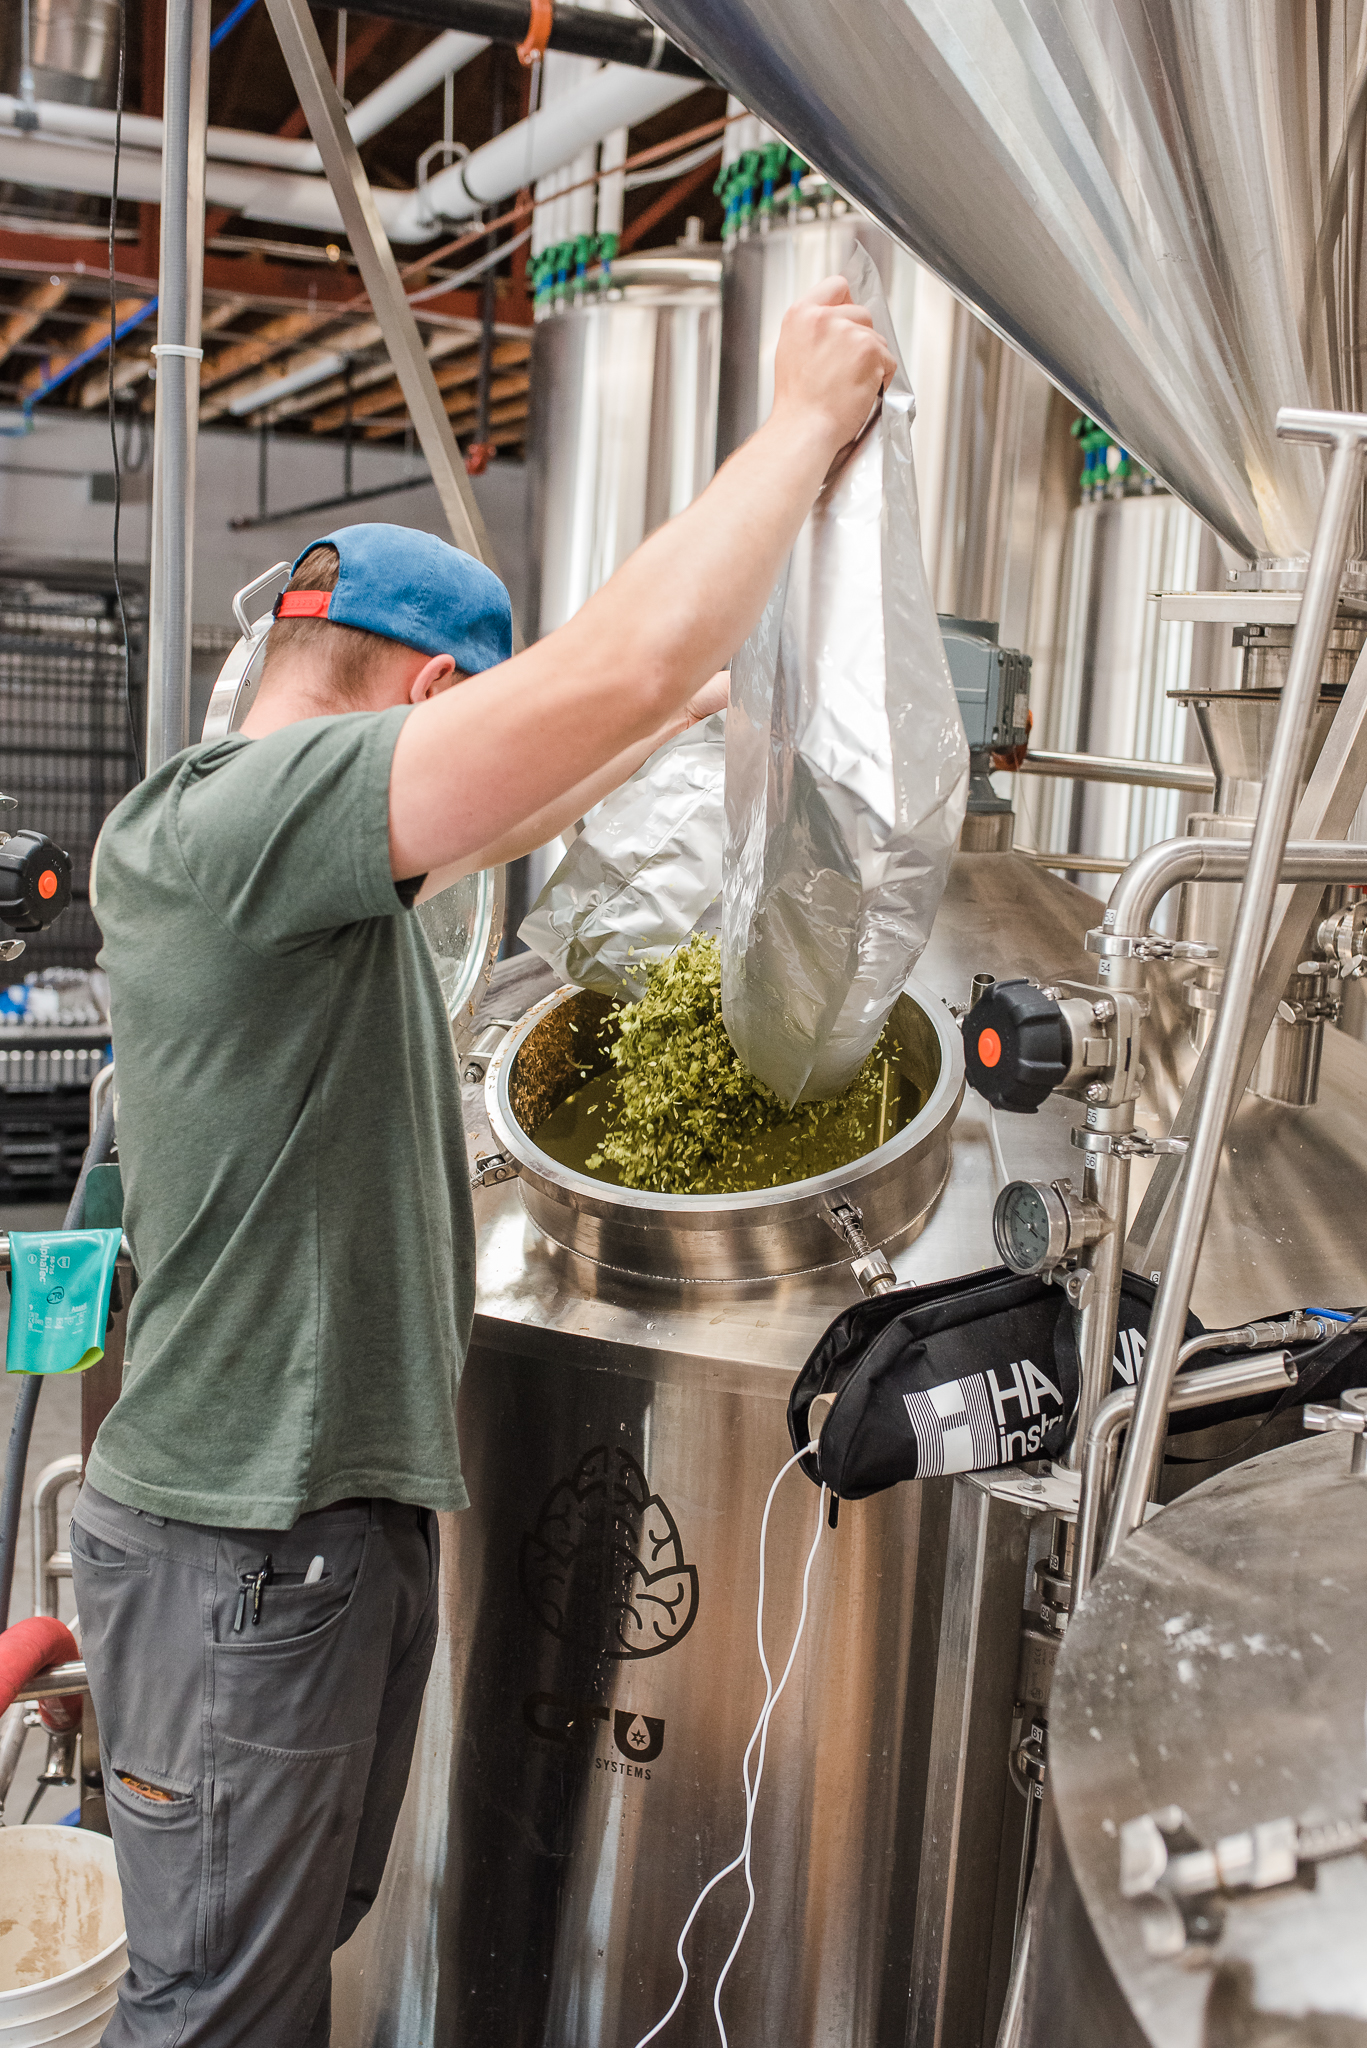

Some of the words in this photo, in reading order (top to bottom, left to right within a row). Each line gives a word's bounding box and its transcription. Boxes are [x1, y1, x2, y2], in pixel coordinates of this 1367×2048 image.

[1104, 911, 1114, 923] 53
[1101, 962, 1110, 973] 54
[1086, 1155, 1096, 1167] 56
[39, 1239, 50, 1283] AlphaTec
[1152, 1273, 1159, 1283] G
[1032, 1728, 1041, 1740] 61
[595, 1757, 652, 1780] SYSTEMS
